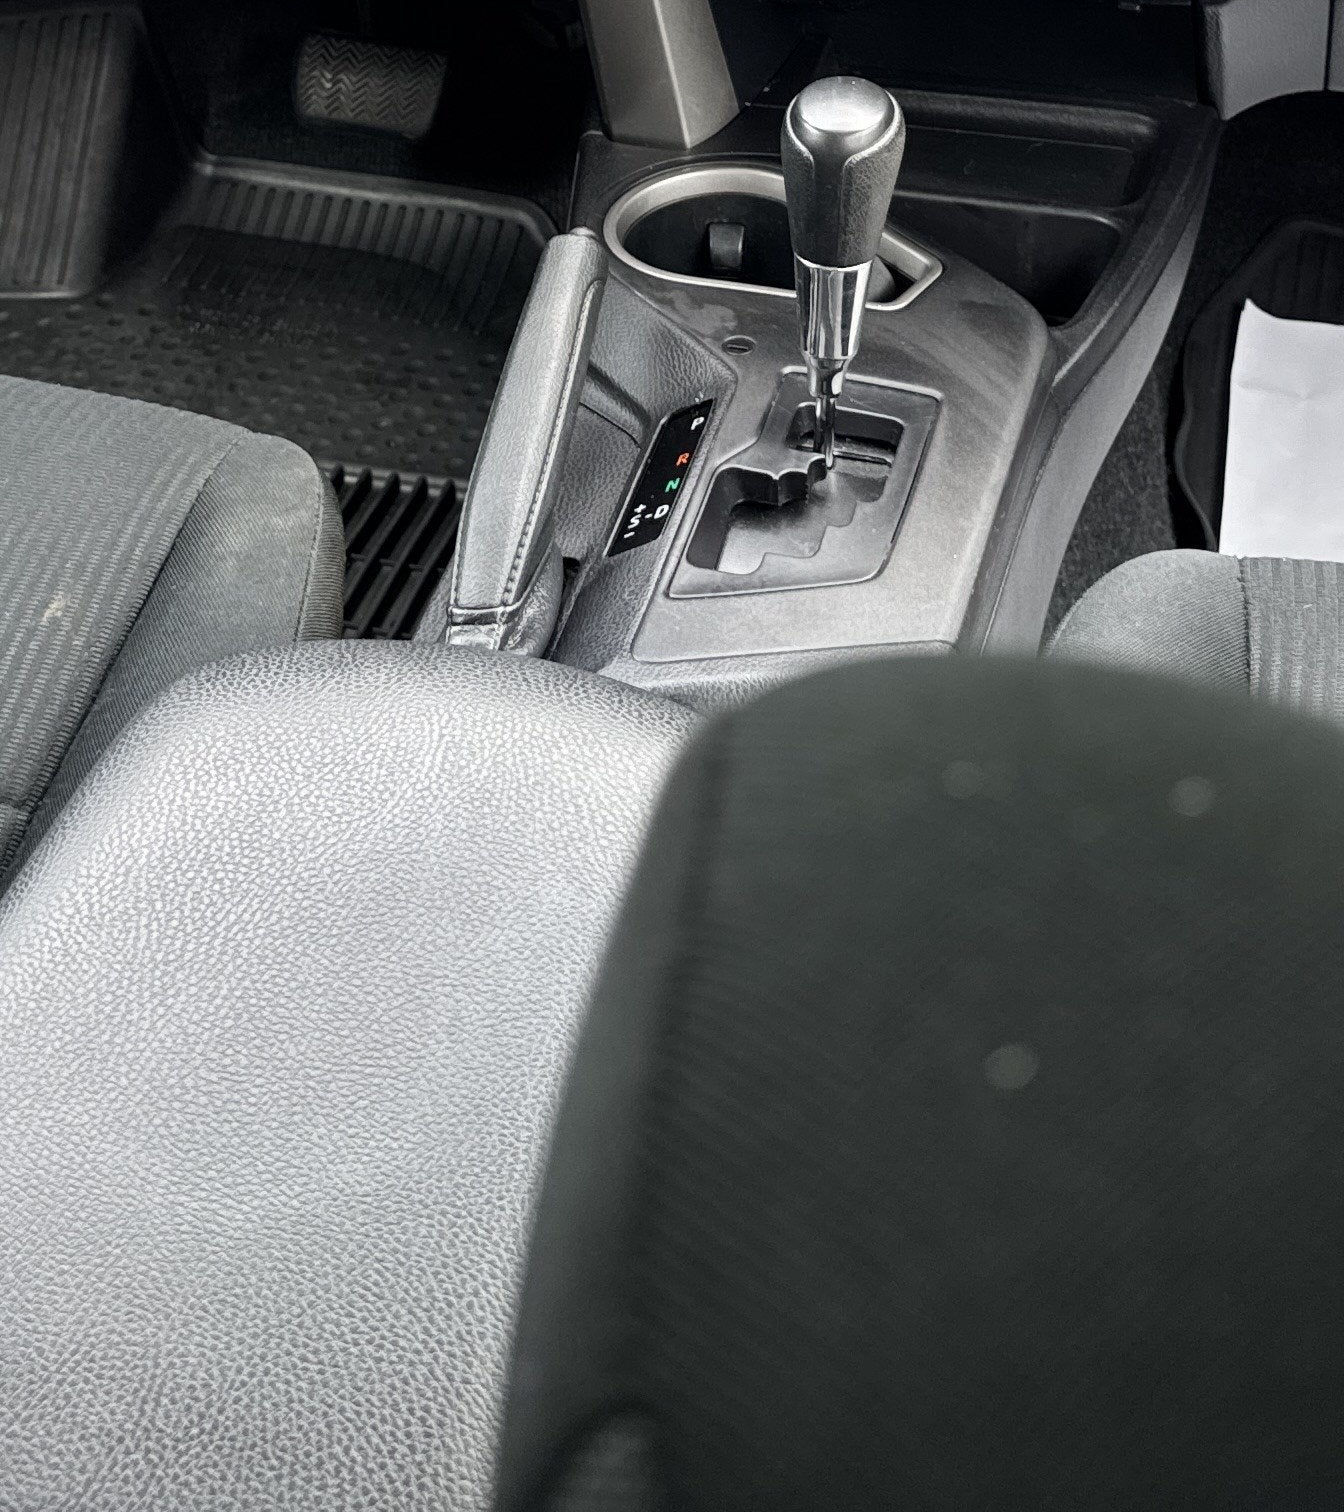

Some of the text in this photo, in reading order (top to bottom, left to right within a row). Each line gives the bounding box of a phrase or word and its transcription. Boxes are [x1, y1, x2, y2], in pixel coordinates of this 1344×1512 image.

[690, 416, 705, 431] P
[676, 452, 690, 467] R
[665, 477, 681, 493] N
[627, 504, 669, 529] S D
